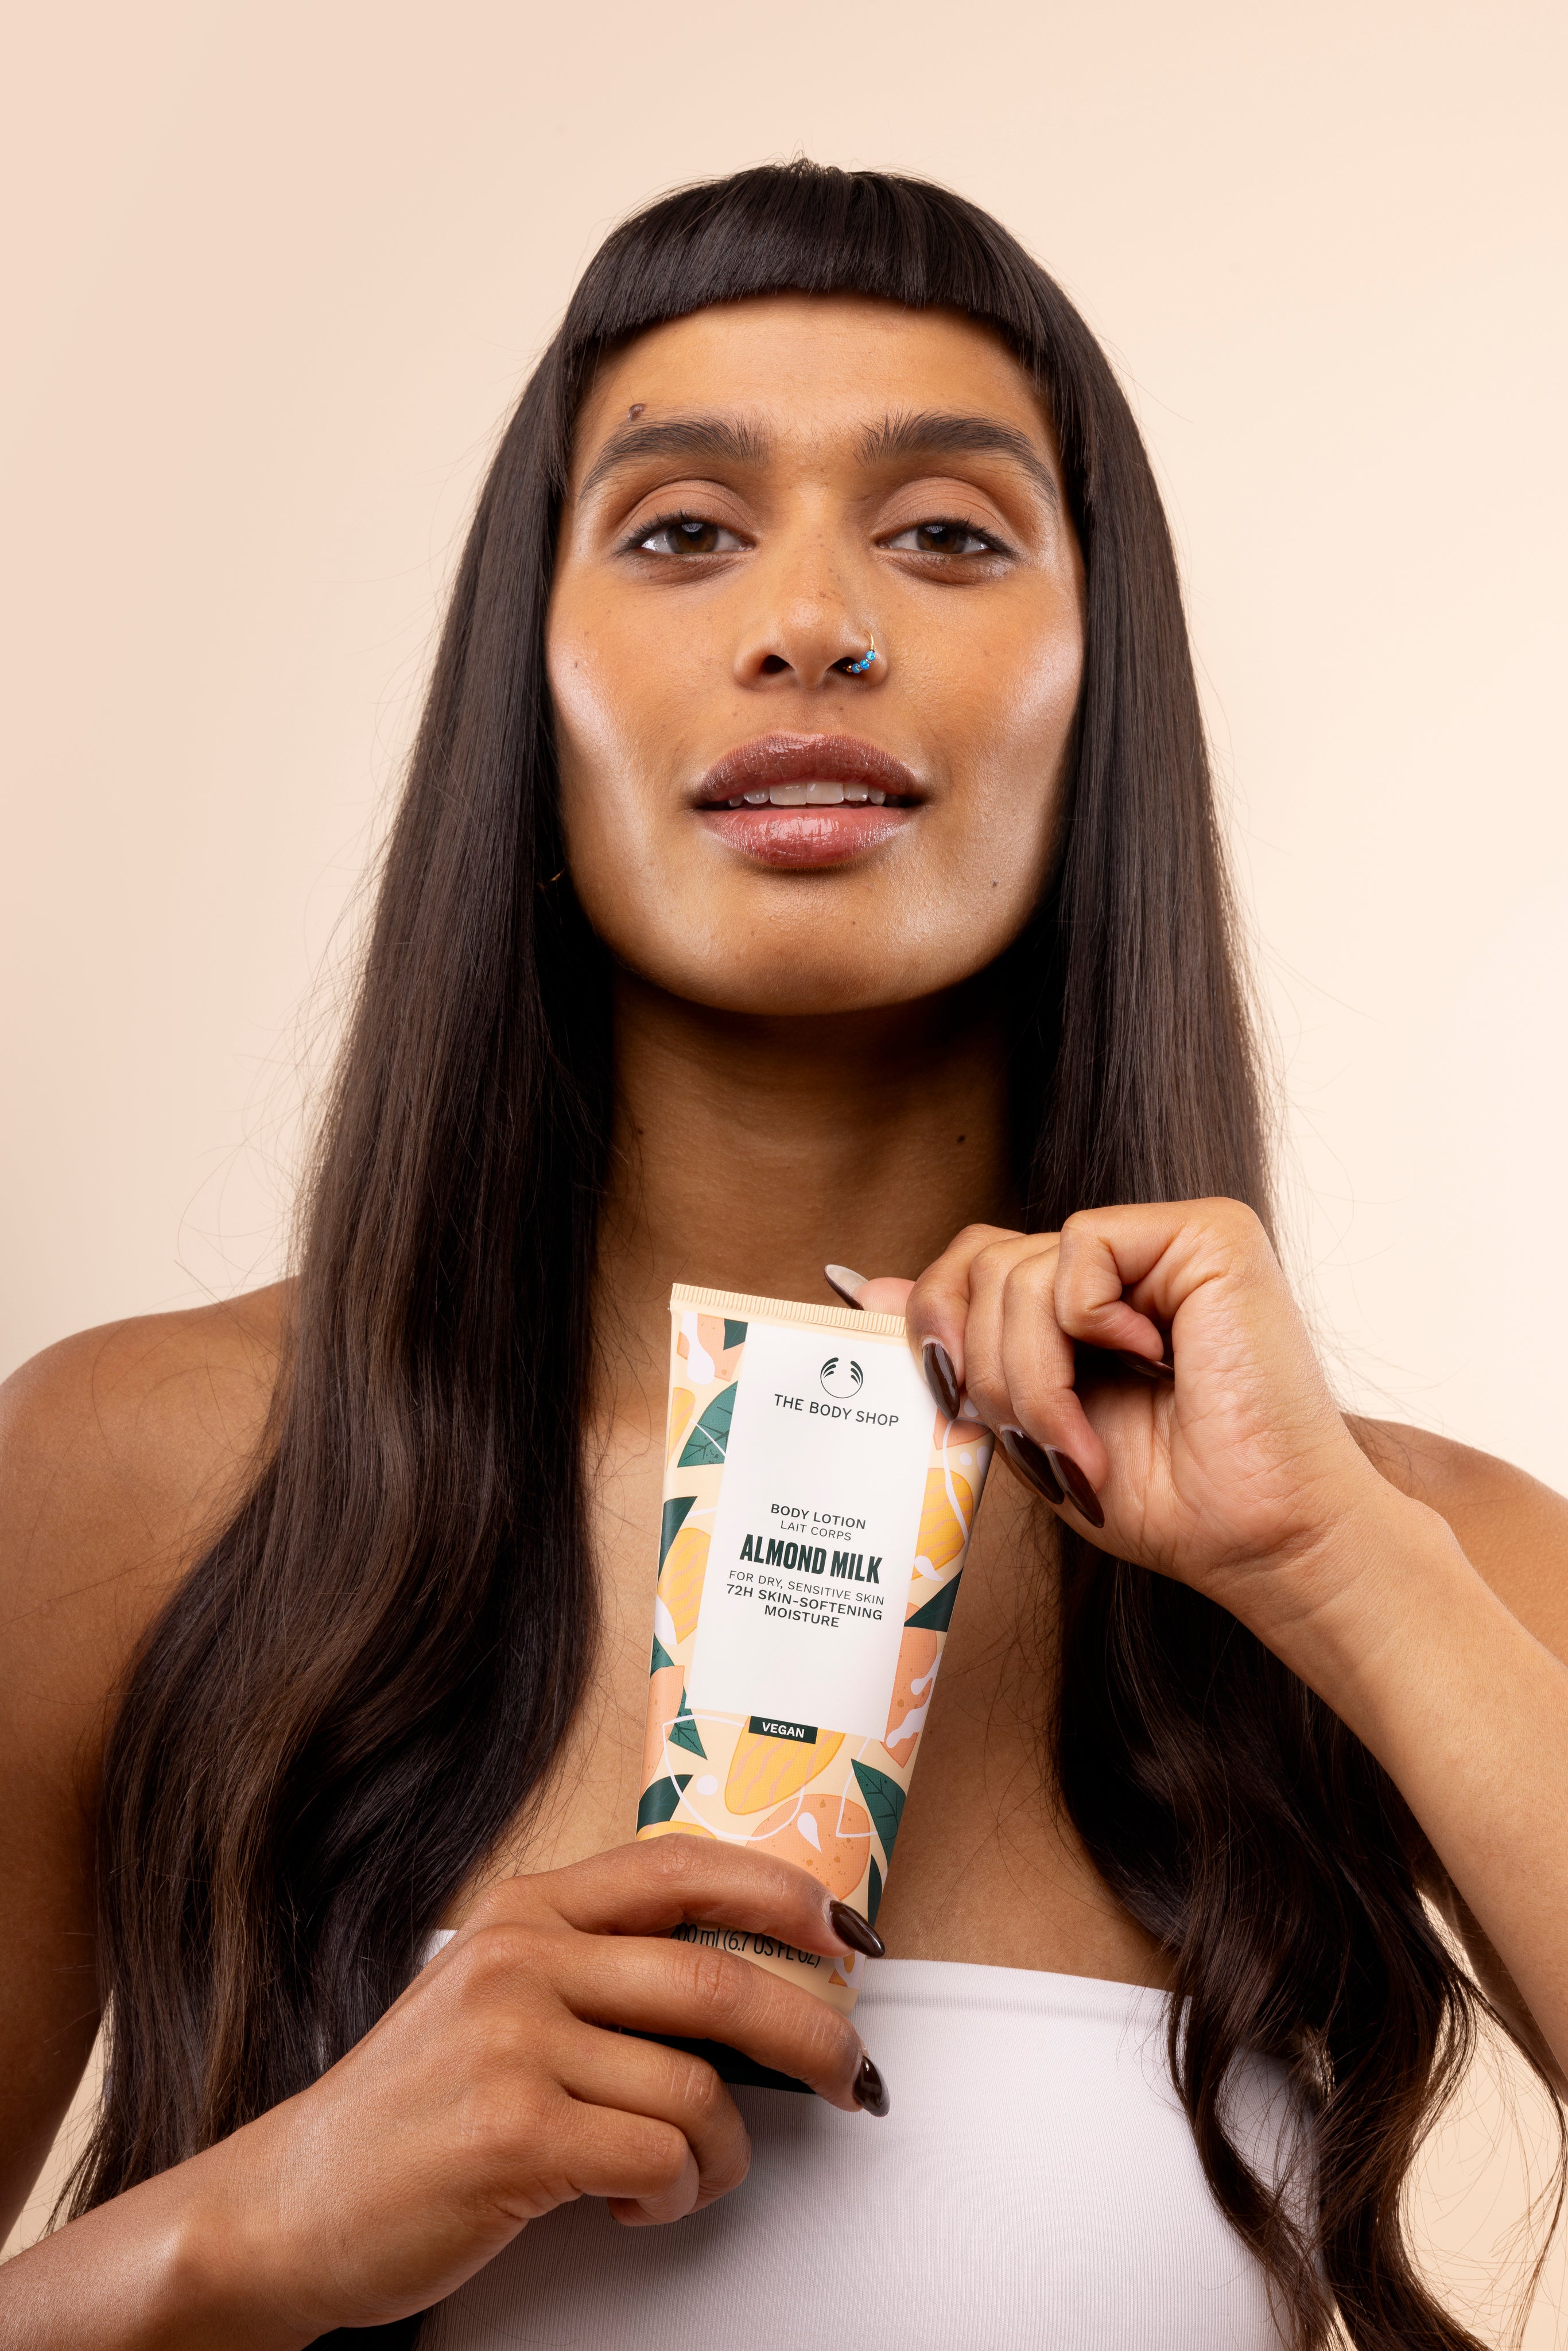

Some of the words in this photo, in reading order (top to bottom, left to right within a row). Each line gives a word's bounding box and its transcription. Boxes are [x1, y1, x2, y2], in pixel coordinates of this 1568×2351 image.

[774, 1394, 804, 1411] THE
[809, 1401, 852, 1420] BODY
[855, 1410, 899, 1427] SHOP
[771, 1503, 809, 1519] BODY
[813, 1512, 866, 1529] LOTION
[781, 1520, 807, 1533] LAIT
[811, 1527, 852, 1541] CORPS
[739, 1534, 826, 1574] ALMOND
[830, 1550, 883, 1584] MILK
[726, 1584, 754, 1597] 72H
[758, 1589, 883, 1620] SKIN-SOFTENING
[729, 1570, 754, 1582] FOR
[758, 1575, 783, 1589] DRY,
[787, 1581, 851, 1600] SENSITIVE
[855, 1593, 884, 1605] SKIN
[764, 1605, 840, 1627] MOISTURE
[762, 1722, 805, 1738] VEGAN
[700, 1927, 721, 1947] ml
[723, 1929, 748, 1952] (6.7
[754, 1933, 774, 1956] US
[777, 1941, 794, 1961] FL
